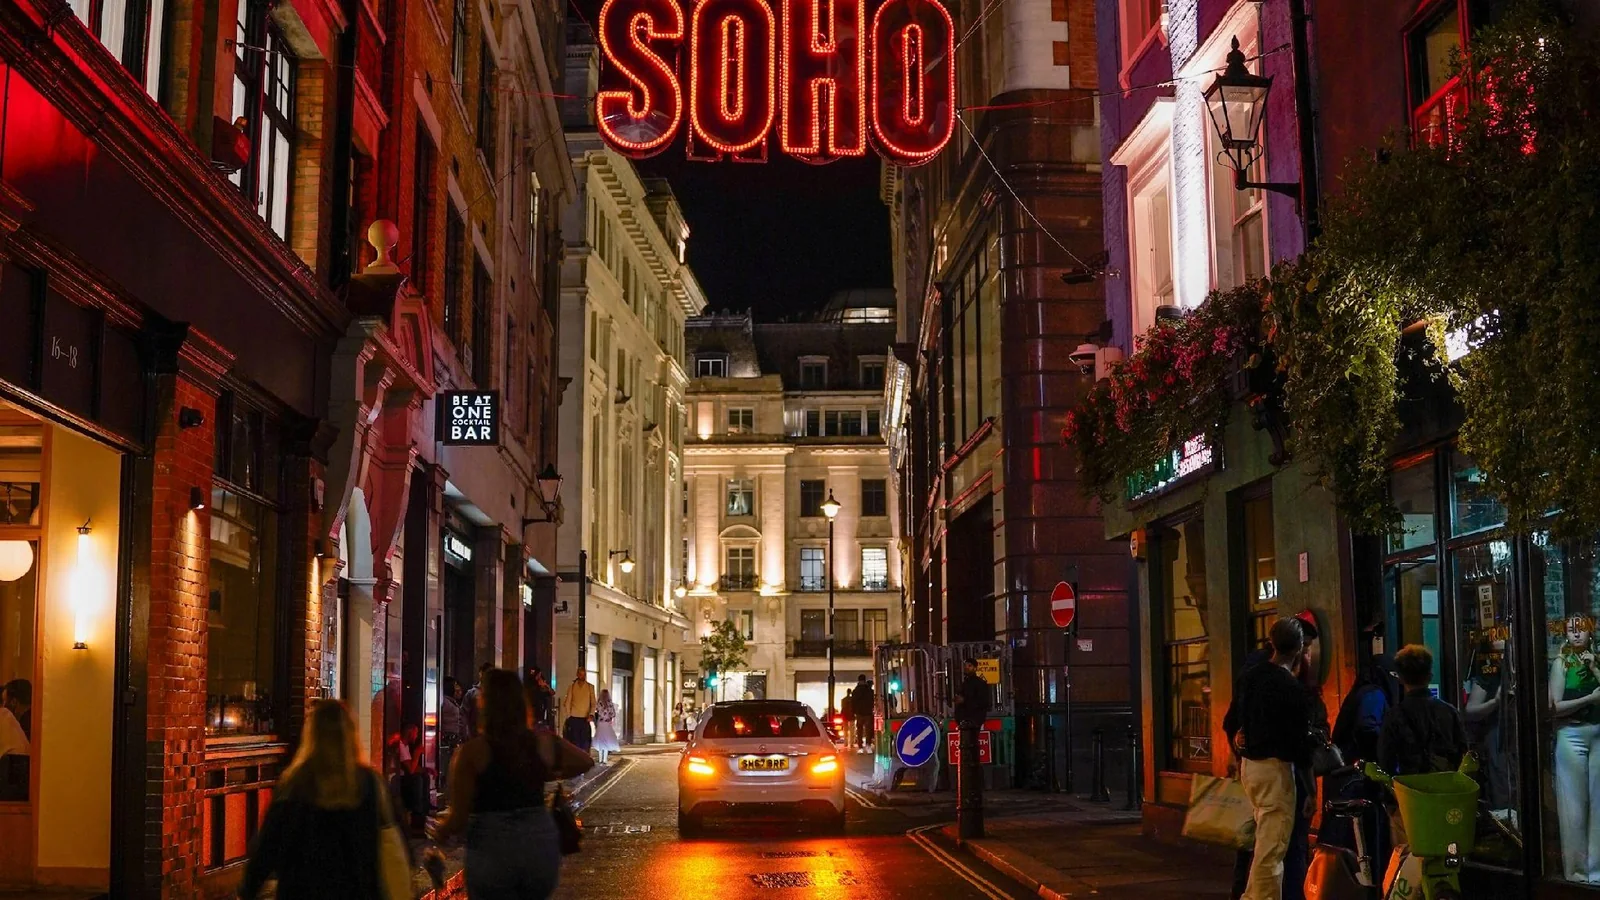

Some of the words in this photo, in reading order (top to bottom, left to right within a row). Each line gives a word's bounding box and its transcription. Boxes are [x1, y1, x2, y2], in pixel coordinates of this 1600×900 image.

[597, 0, 955, 158] SOHO
[452, 395, 469, 406] BE
[474, 395, 491, 406] AT
[452, 406, 491, 419] ONE
[451, 426, 491, 440] BAR
